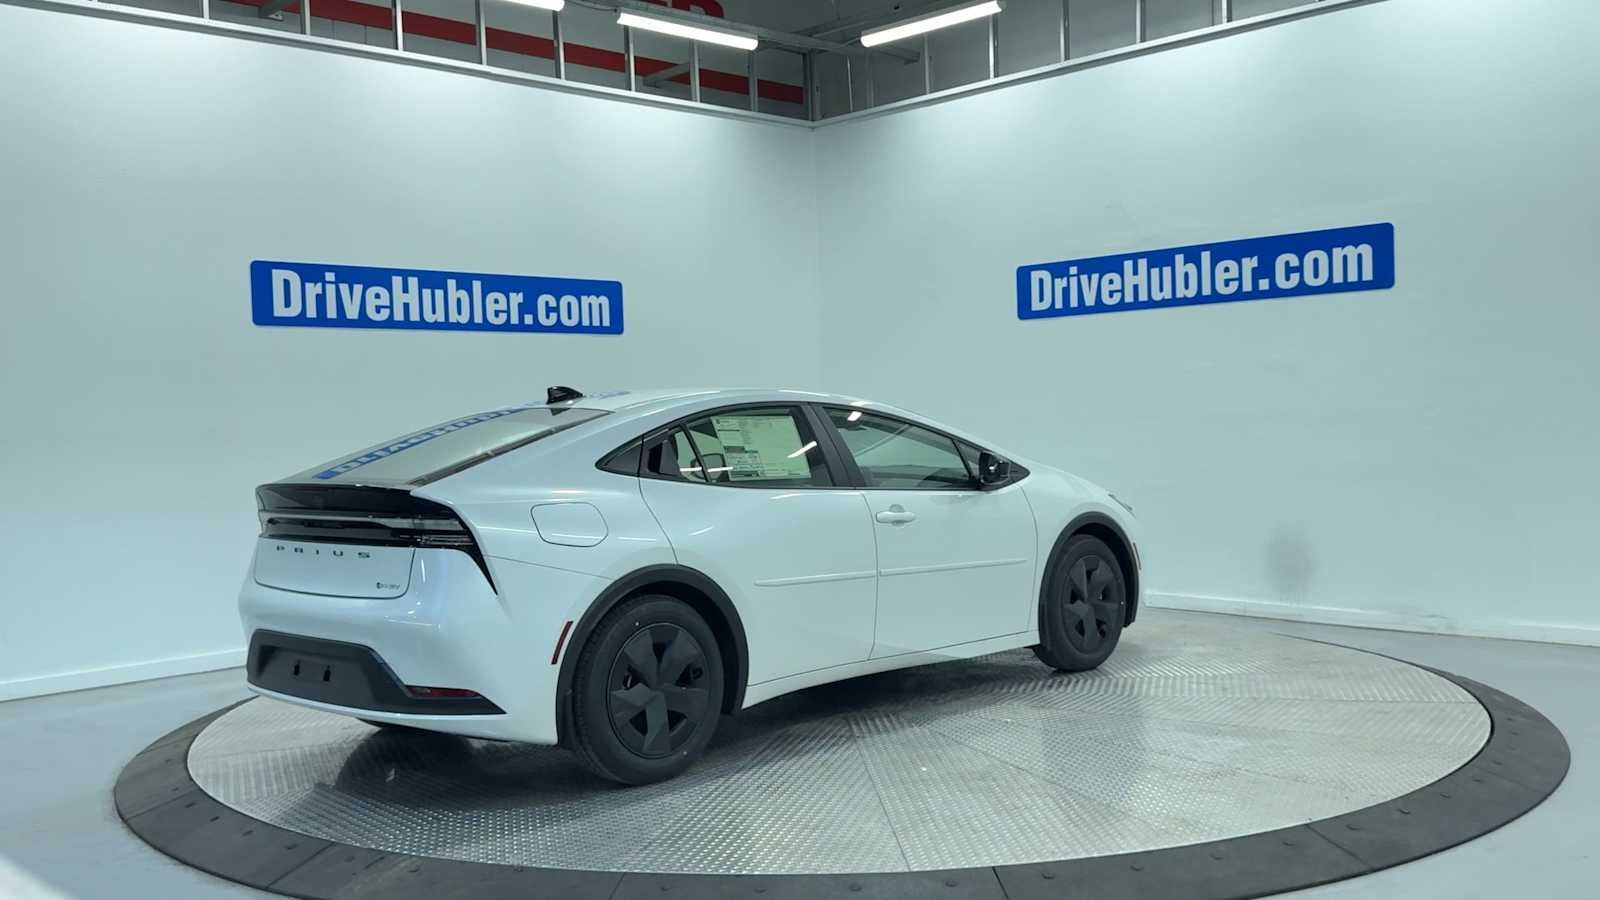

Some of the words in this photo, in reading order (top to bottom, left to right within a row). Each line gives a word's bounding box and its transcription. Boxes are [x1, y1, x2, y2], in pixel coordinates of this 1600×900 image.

[270, 268, 612, 328] DriveHubler.com
[1030, 242, 1375, 312] DriveHubler.com
[275, 544, 371, 559] PRIUS
